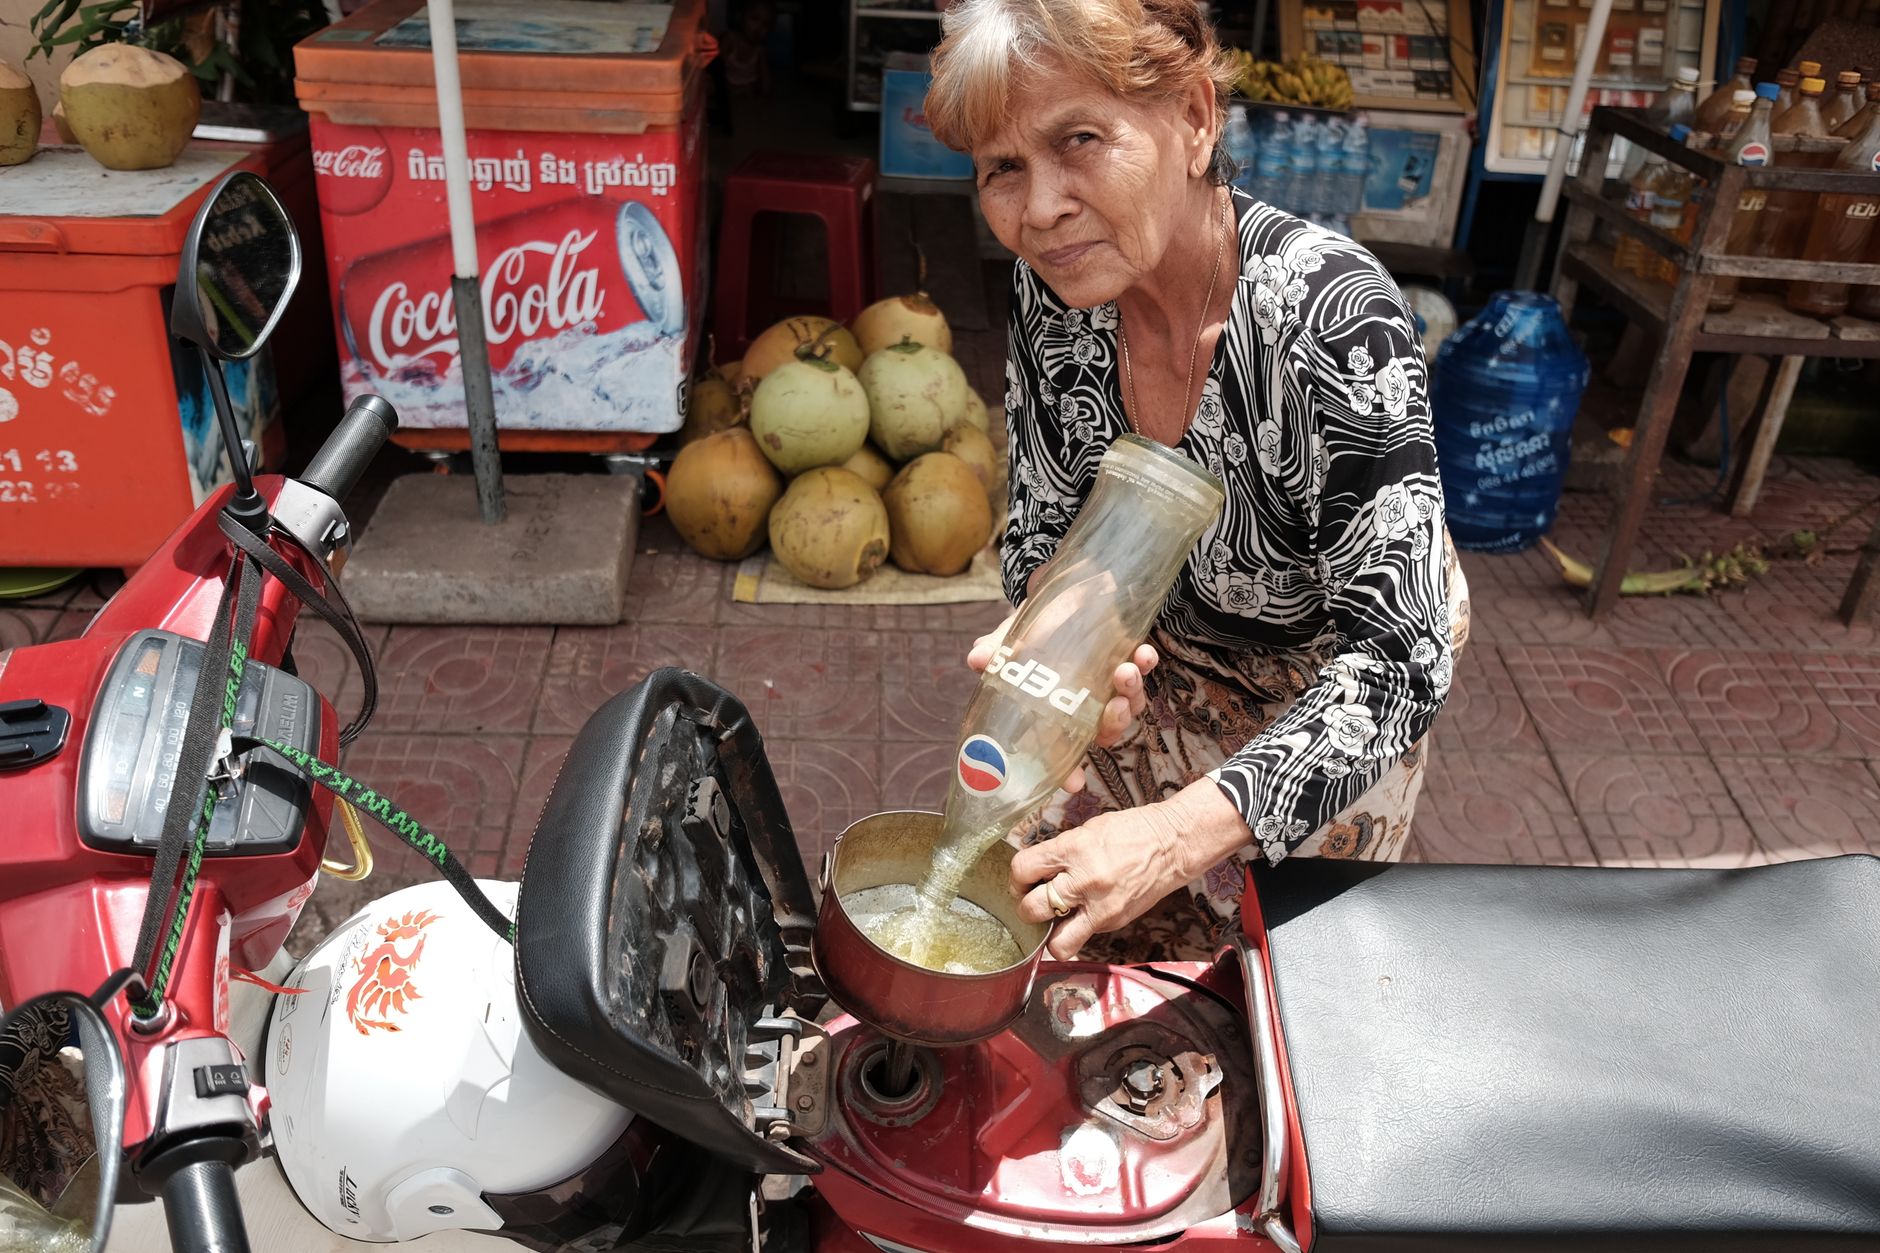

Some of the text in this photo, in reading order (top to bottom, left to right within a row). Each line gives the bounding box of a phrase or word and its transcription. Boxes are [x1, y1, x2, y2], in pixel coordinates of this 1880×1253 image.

[133, 686, 145, 698] N
[985, 645, 1090, 716] PEPS
[154, 702, 187, 814] 40 60 80 100 120
